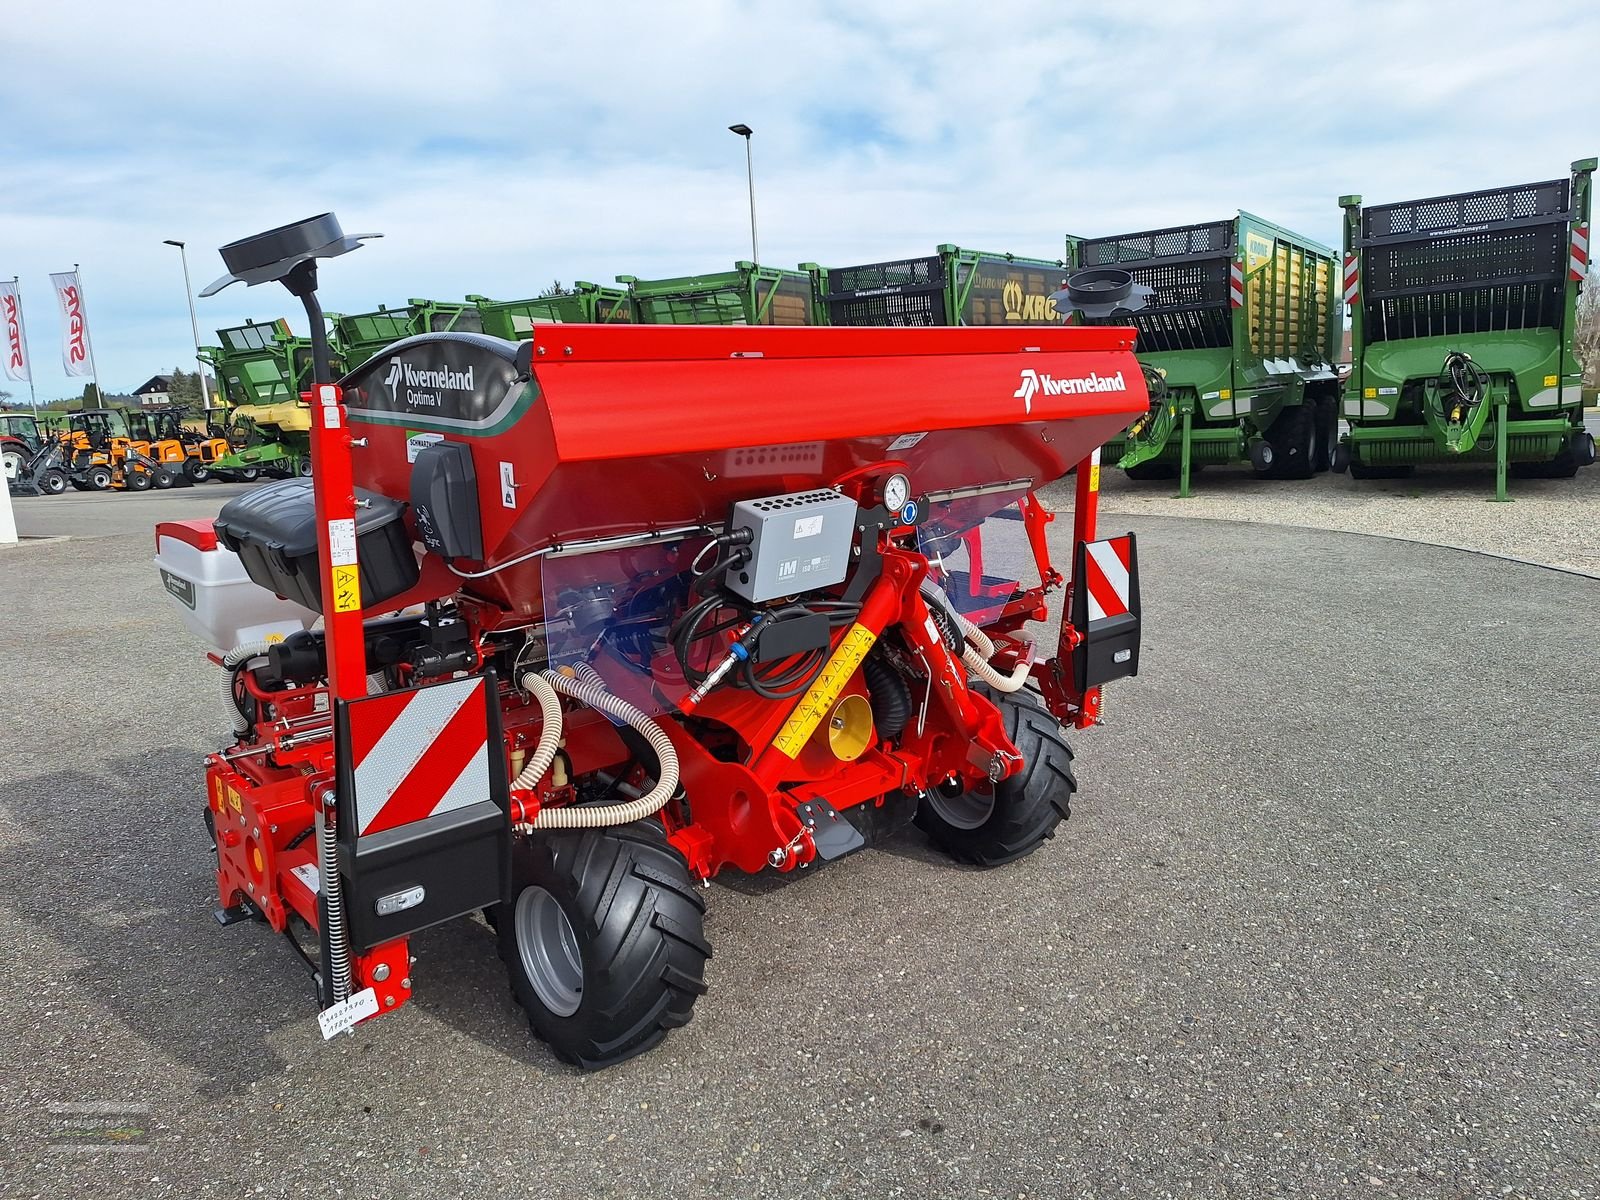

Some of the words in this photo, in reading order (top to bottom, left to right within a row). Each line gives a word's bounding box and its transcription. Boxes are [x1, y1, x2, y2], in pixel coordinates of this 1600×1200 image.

[1429, 224, 1489, 236] www.schwarzmayr.at
[403, 363, 475, 390] Kverneland
[1039, 371, 1126, 395] Kverneland
[406, 389, 435, 408] Optima
[436, 391, 442, 407] V
[778, 560, 797, 577] iM
